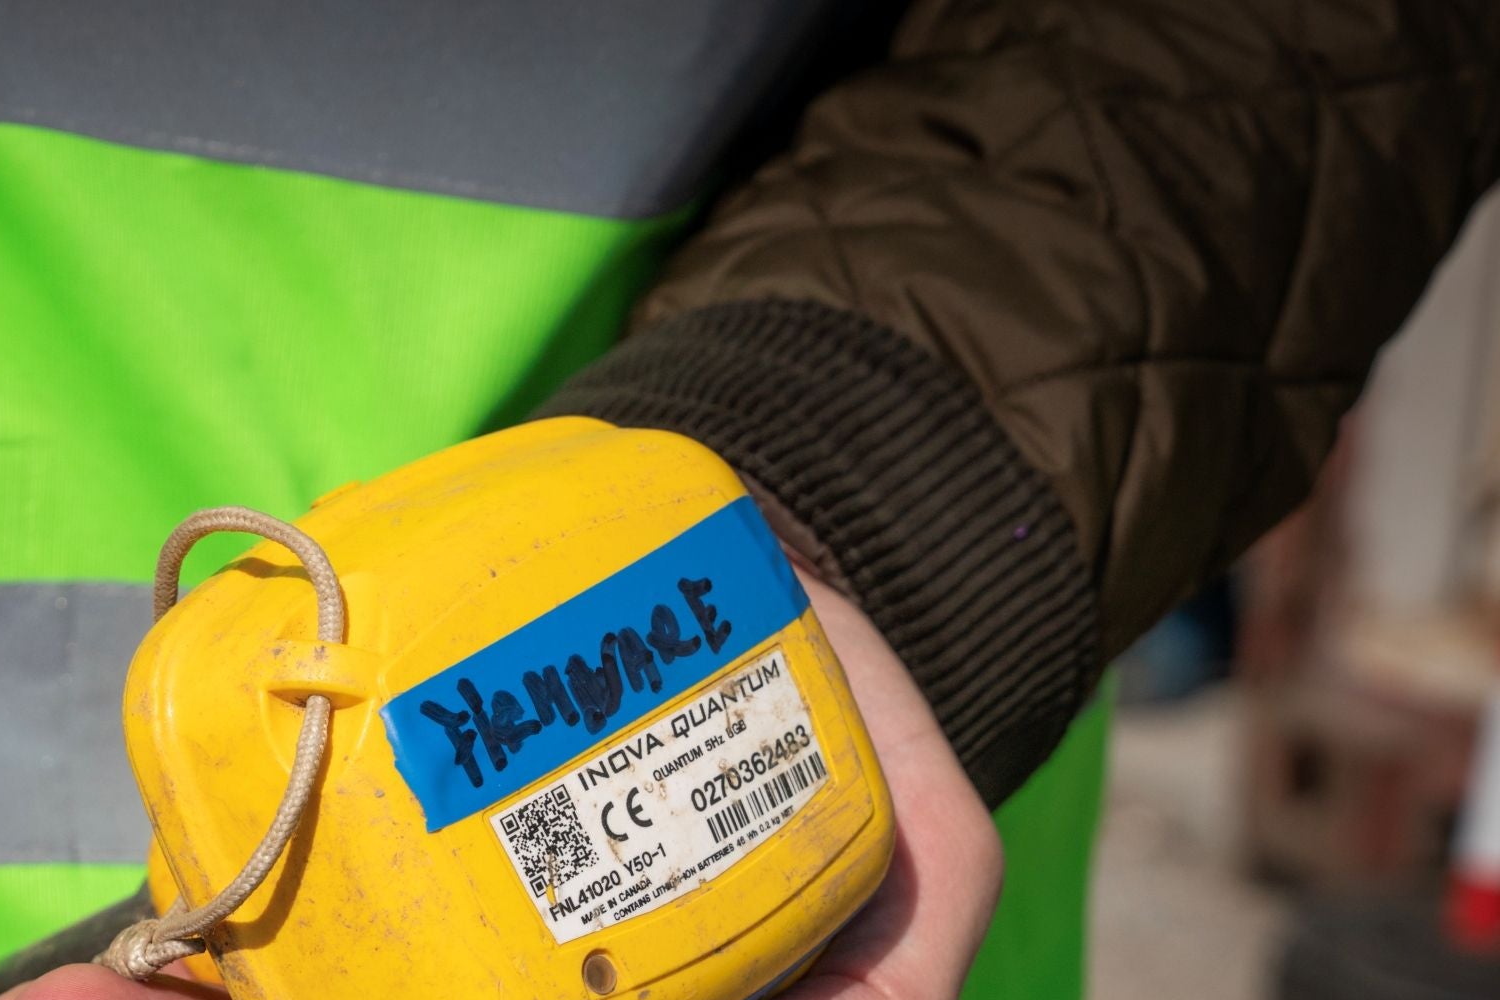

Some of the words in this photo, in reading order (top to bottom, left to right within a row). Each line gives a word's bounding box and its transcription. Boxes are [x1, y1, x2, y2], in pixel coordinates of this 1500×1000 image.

[577, 732, 665, 791] INOVA
[670, 658, 780, 738] QUANTUM
[653, 745, 704, 782] QUANTUM
[705, 735, 725, 752] 5Hz
[690, 724, 810, 812] 0270362483
[601, 787, 653, 842] CE
[549, 870, 621, 922] FNL41020
[623, 842, 667, 877] Y50-1
[581, 904, 607, 925] MADE
[607, 897, 618, 910] IN
[618, 878, 652, 902] CANADA
[613, 893, 651, 921] CONTAINS
[697, 843, 735, 872] BATTERIES
[758, 820, 771, 833] 0.2
[770, 815, 781, 826] kg
[781, 805, 795, 819] NET
